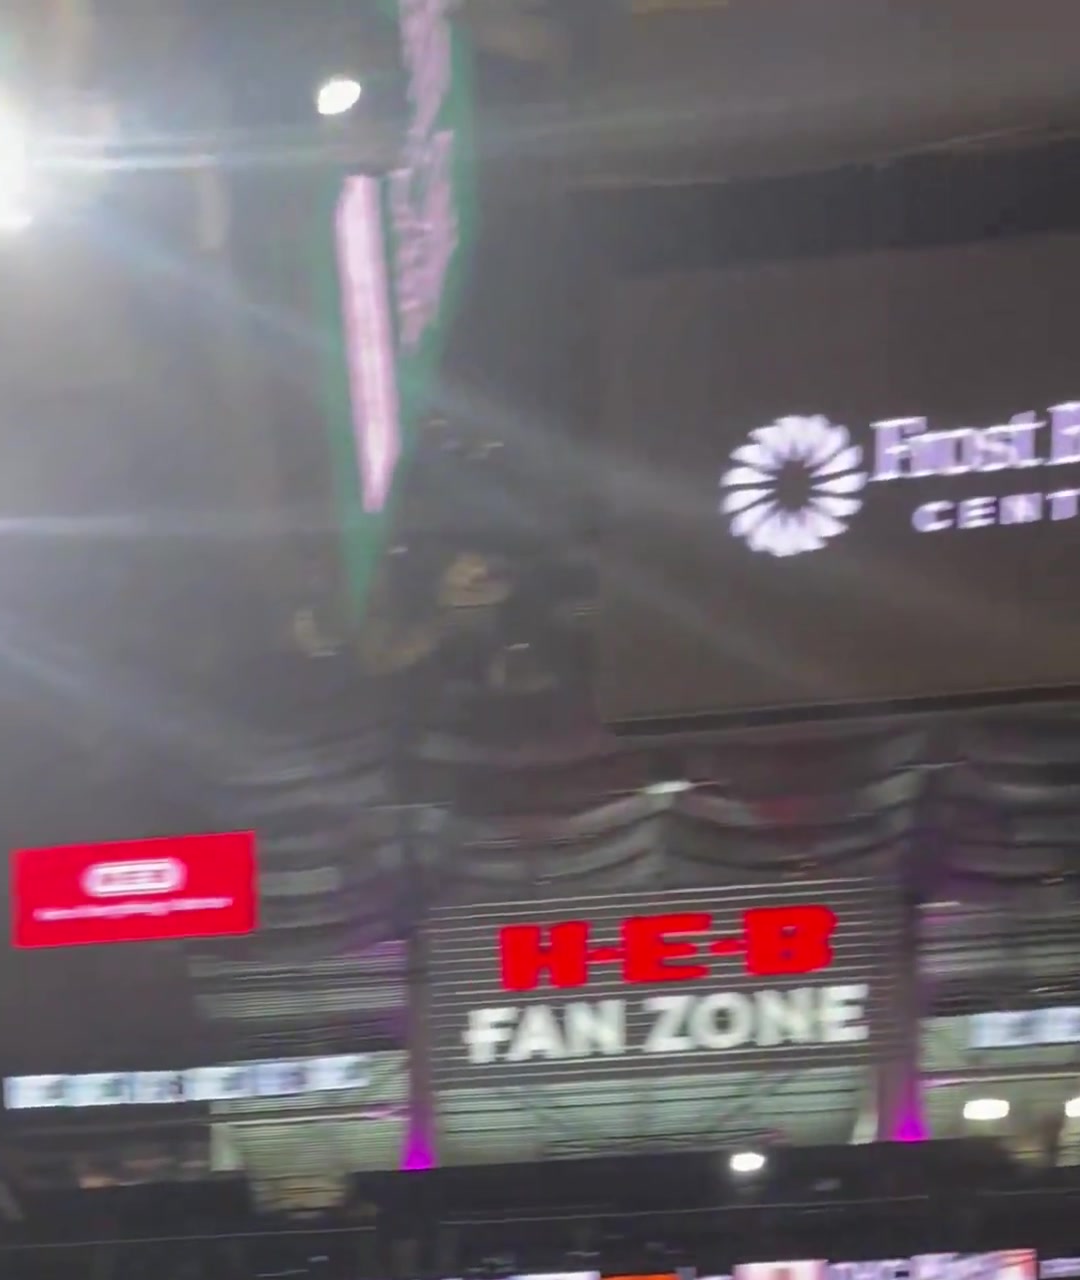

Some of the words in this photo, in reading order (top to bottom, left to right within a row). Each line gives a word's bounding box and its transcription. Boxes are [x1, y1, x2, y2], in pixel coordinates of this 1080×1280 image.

[912, 488, 1080, 533] CENT
[499, 905, 838, 992] H-E-B
[462, 1000, 627, 1064] FAN
[642, 983, 869, 1053] ZONE
